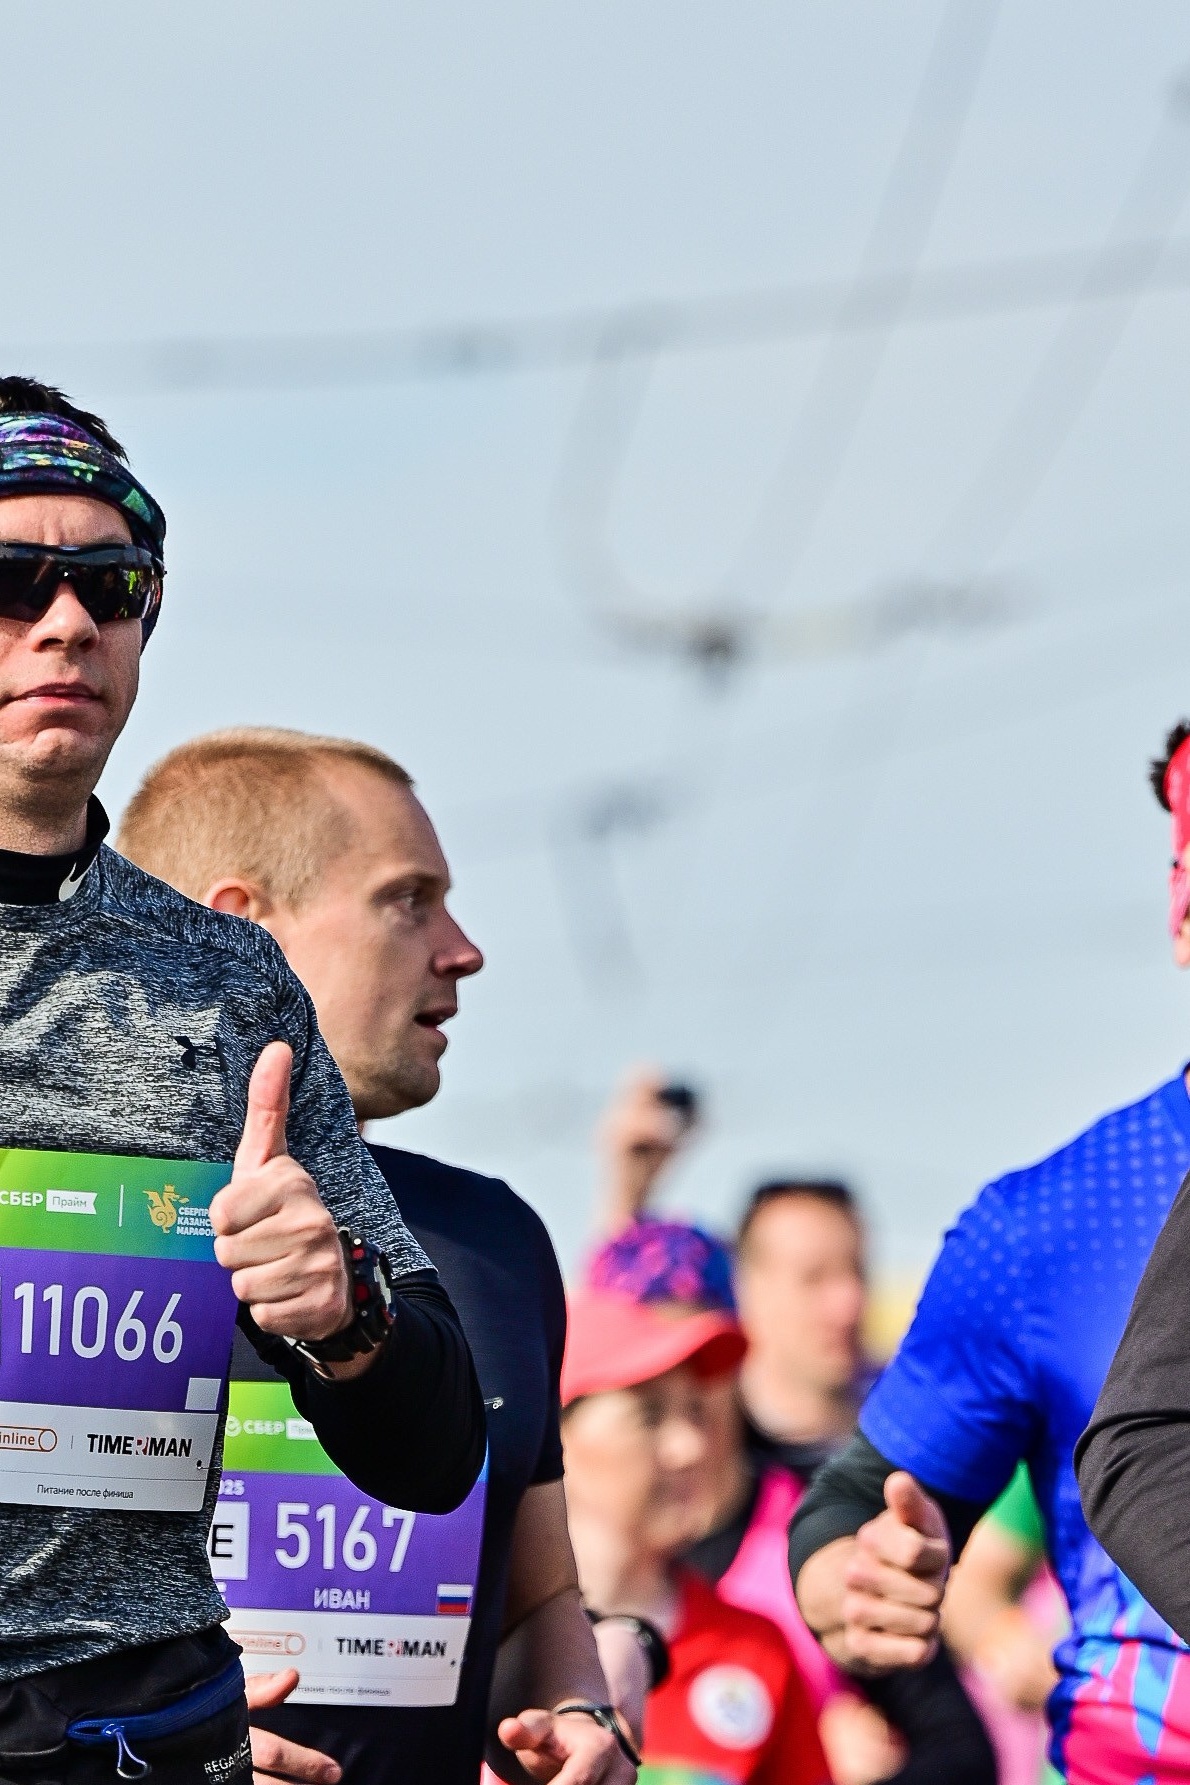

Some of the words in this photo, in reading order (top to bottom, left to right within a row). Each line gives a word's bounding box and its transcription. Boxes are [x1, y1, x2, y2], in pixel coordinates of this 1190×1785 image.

[52, 1196, 87, 1208] Прайм
[178, 1206, 210, 1217] СБЕРПР
[177, 1216, 213, 1227] КАЗАНС
[14, 1281, 184, 1364] 11066
[37, 1484, 74, 1496] Питание
[76, 1488, 102, 1498] после
[102, 1488, 134, 1499] финиша
[211, 1524, 234, 1557] E
[275, 1501, 417, 1573] 5167
[313, 1587, 371, 1610] ИВАН
